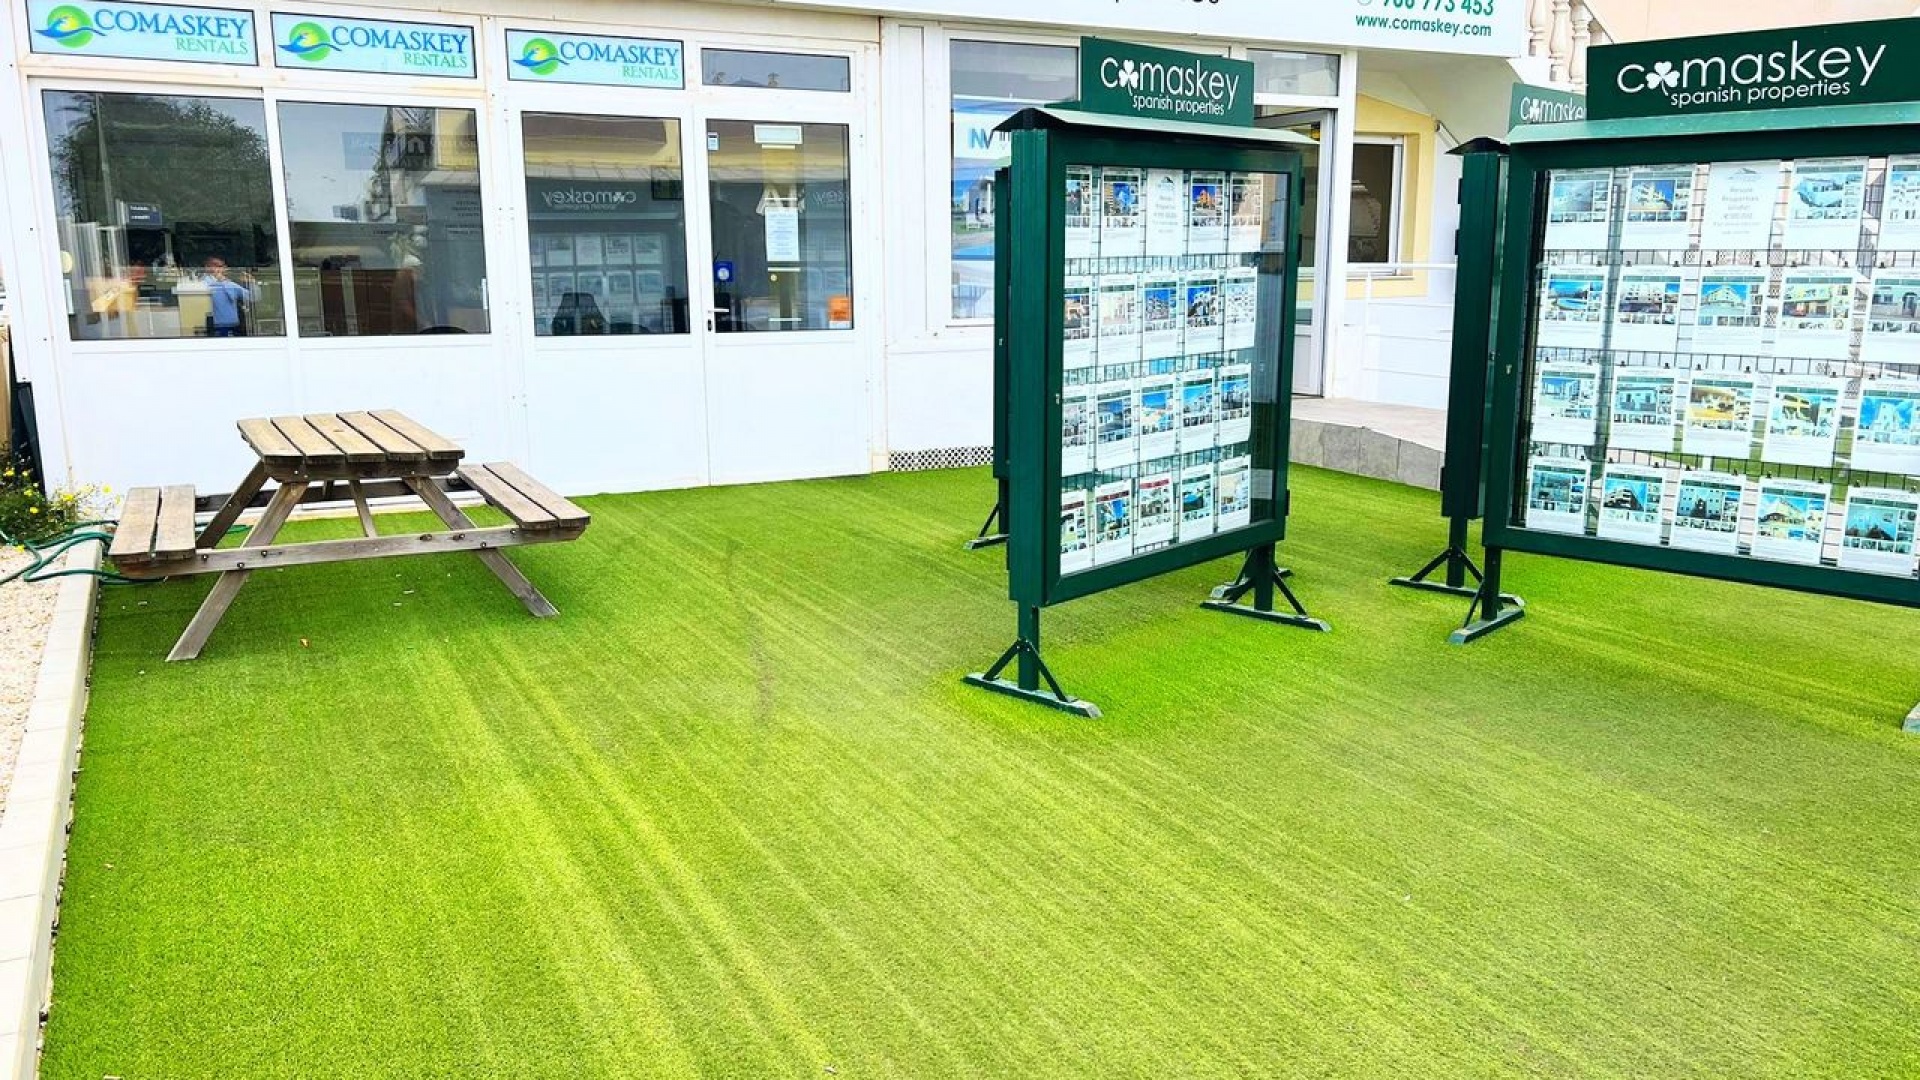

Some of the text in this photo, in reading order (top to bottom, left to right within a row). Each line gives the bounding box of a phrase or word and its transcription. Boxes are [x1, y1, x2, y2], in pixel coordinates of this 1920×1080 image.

[94, 9, 249, 39] COMASKEY
[1355, 15, 1492, 37] www.comaskey.com
[175, 37, 249, 55] RENTALS
[332, 26, 467, 54] COMASKEY
[404, 52, 467, 69] RENTALS
[560, 41, 679, 66] COMASKEY
[622, 65, 679, 81] RENTALS
[1132, 94, 1225, 116] spanish properties
[1670, 80, 1850, 108] spanish properties
